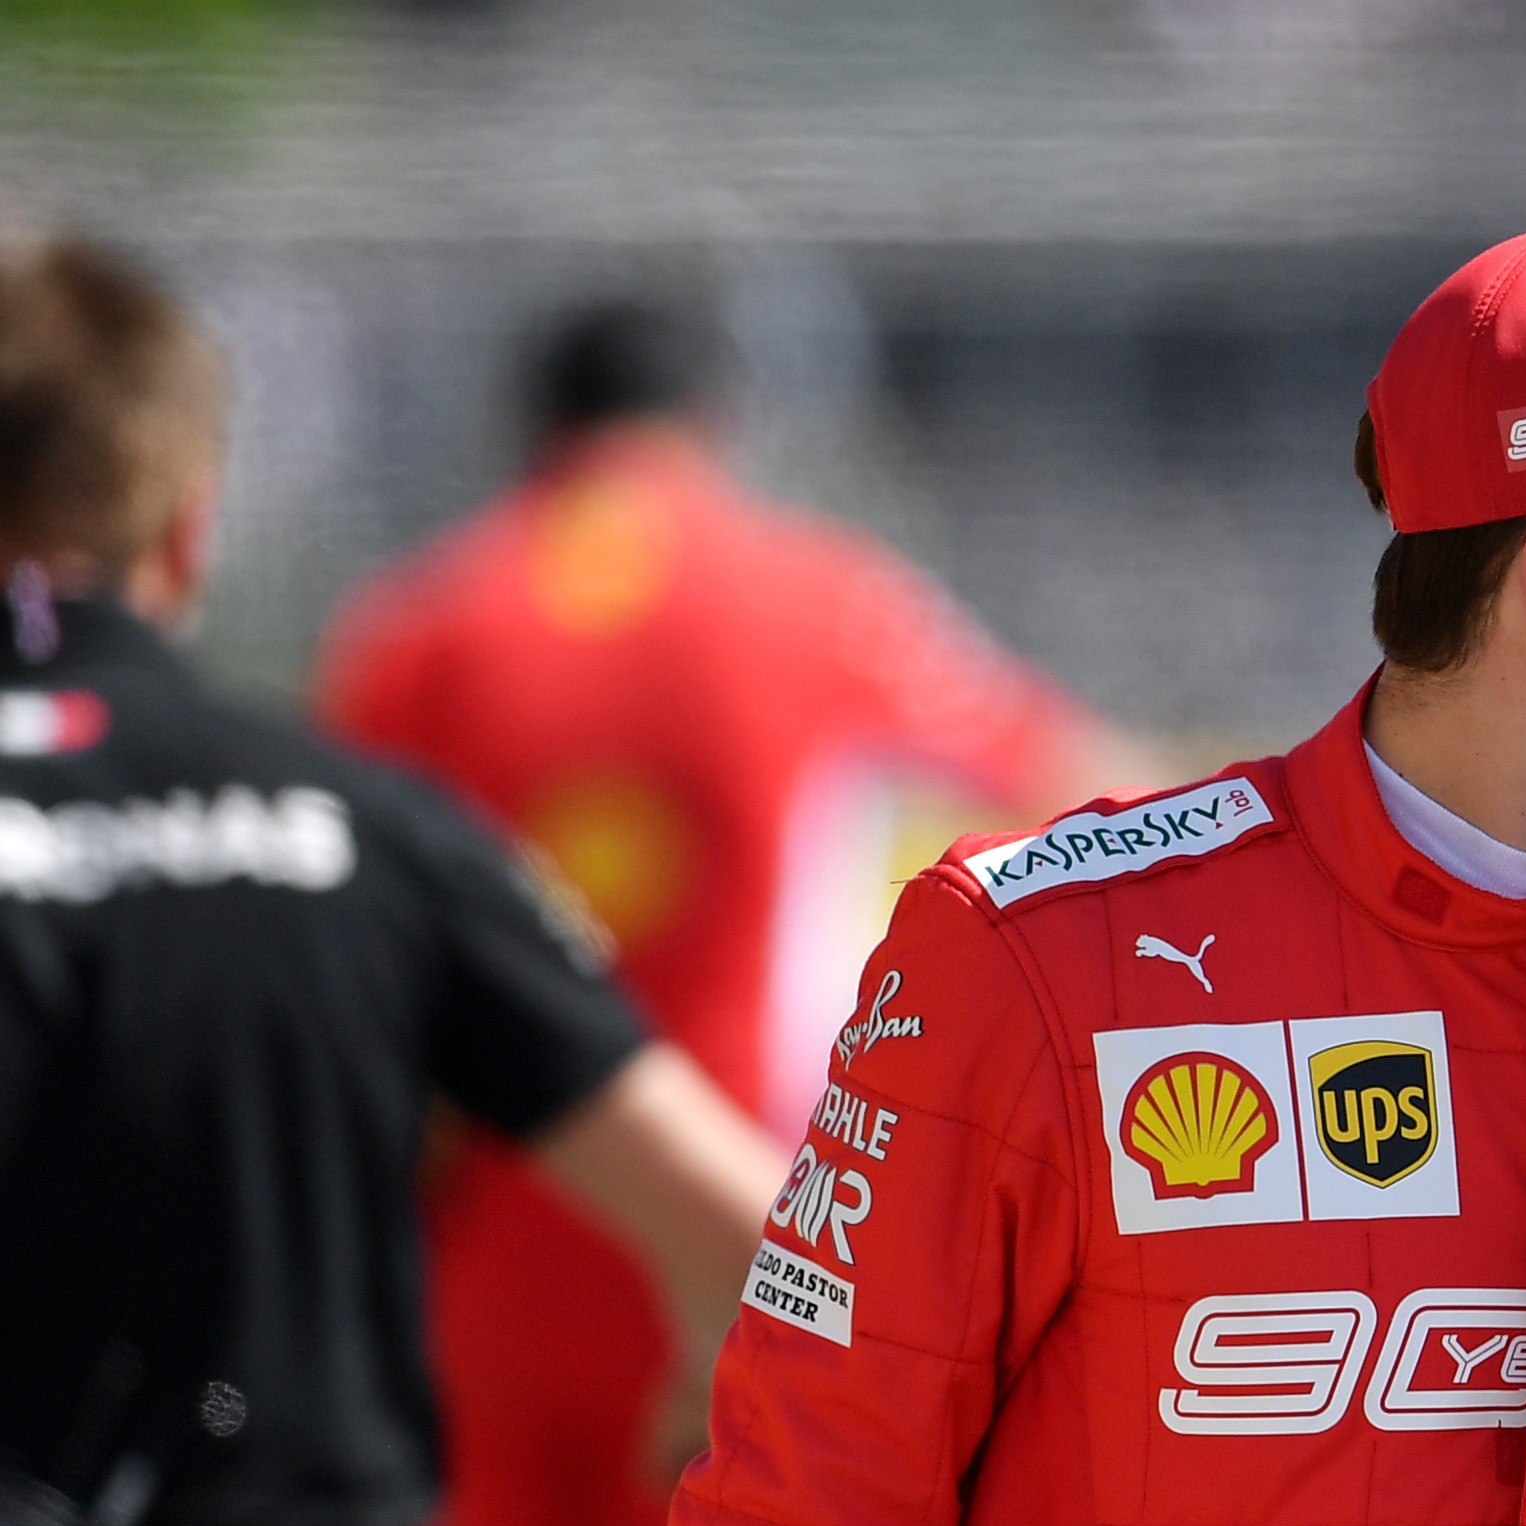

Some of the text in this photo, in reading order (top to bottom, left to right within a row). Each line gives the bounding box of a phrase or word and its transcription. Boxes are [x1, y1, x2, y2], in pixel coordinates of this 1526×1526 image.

[985, 796, 1224, 888] KASPERSKY
[1321, 1086, 1430, 1165] ups
[754, 1279, 819, 1323] CENTER
[781, 1264, 849, 1309] PASTOR
